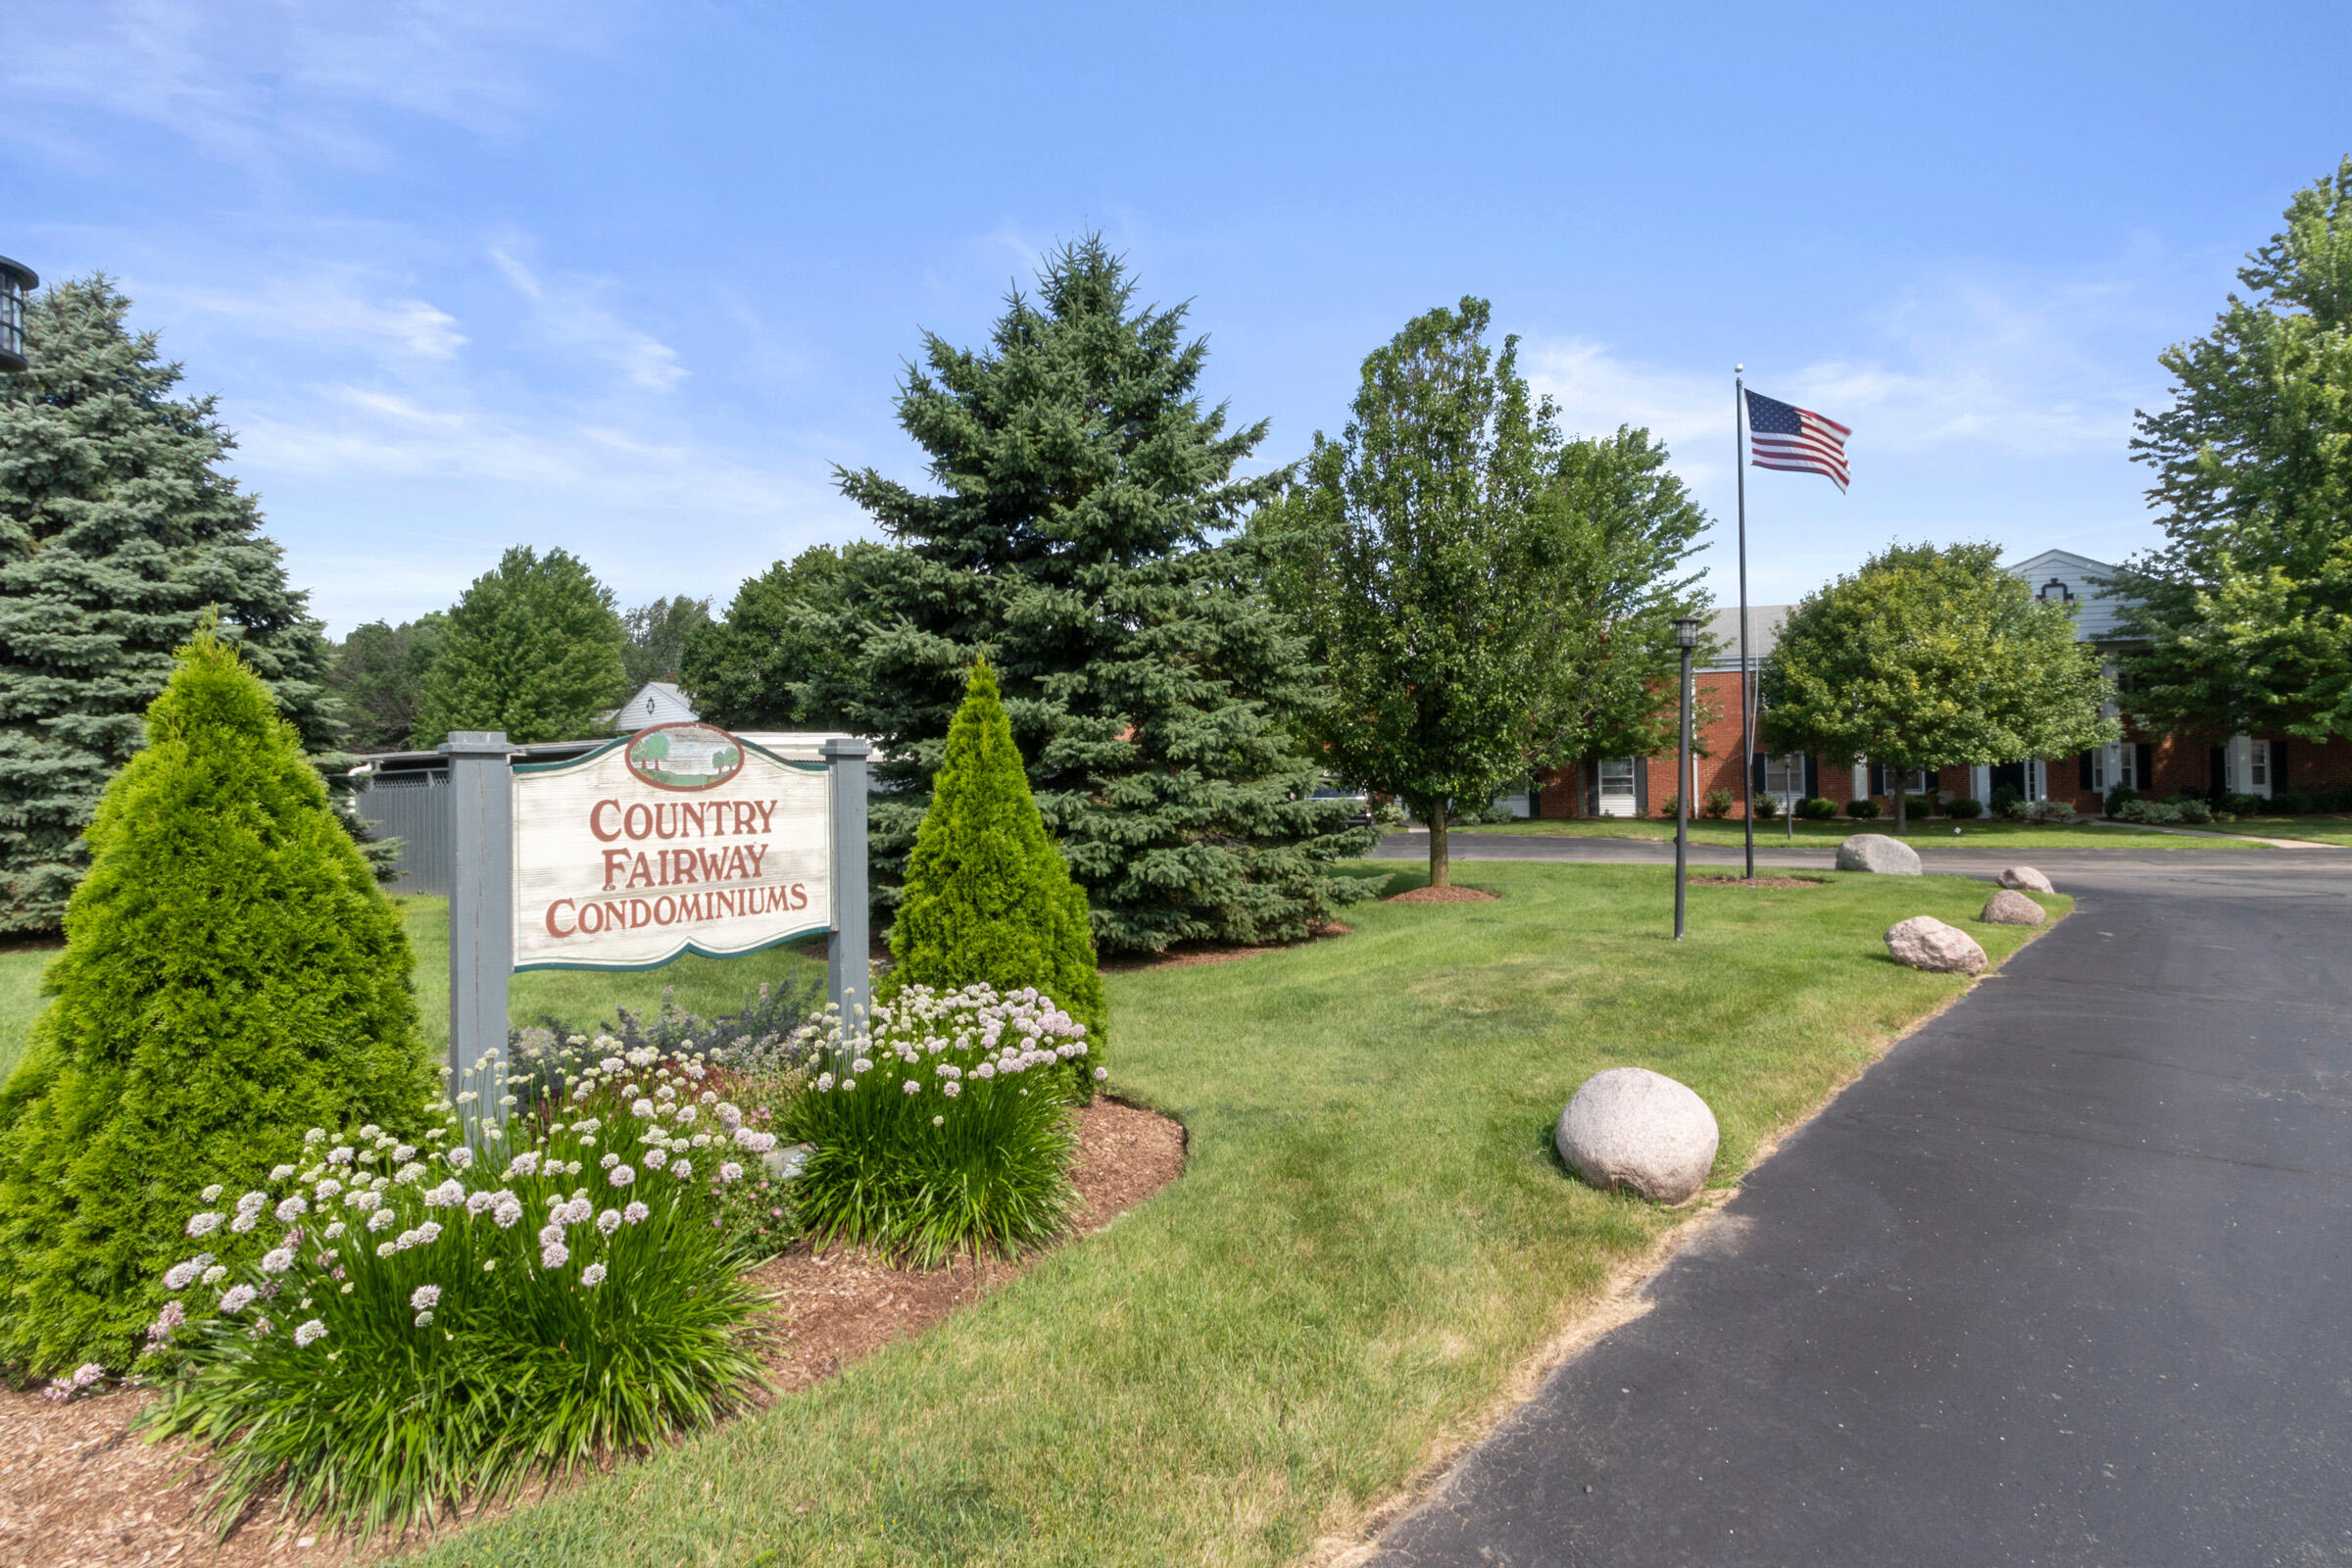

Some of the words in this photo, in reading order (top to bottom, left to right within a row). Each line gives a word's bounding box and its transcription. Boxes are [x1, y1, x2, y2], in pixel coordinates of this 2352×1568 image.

[590, 799, 778, 842] COUNTRY
[602, 844, 768, 891] FAIRWAY
[545, 883, 808, 938] CONDOMINIUMS
